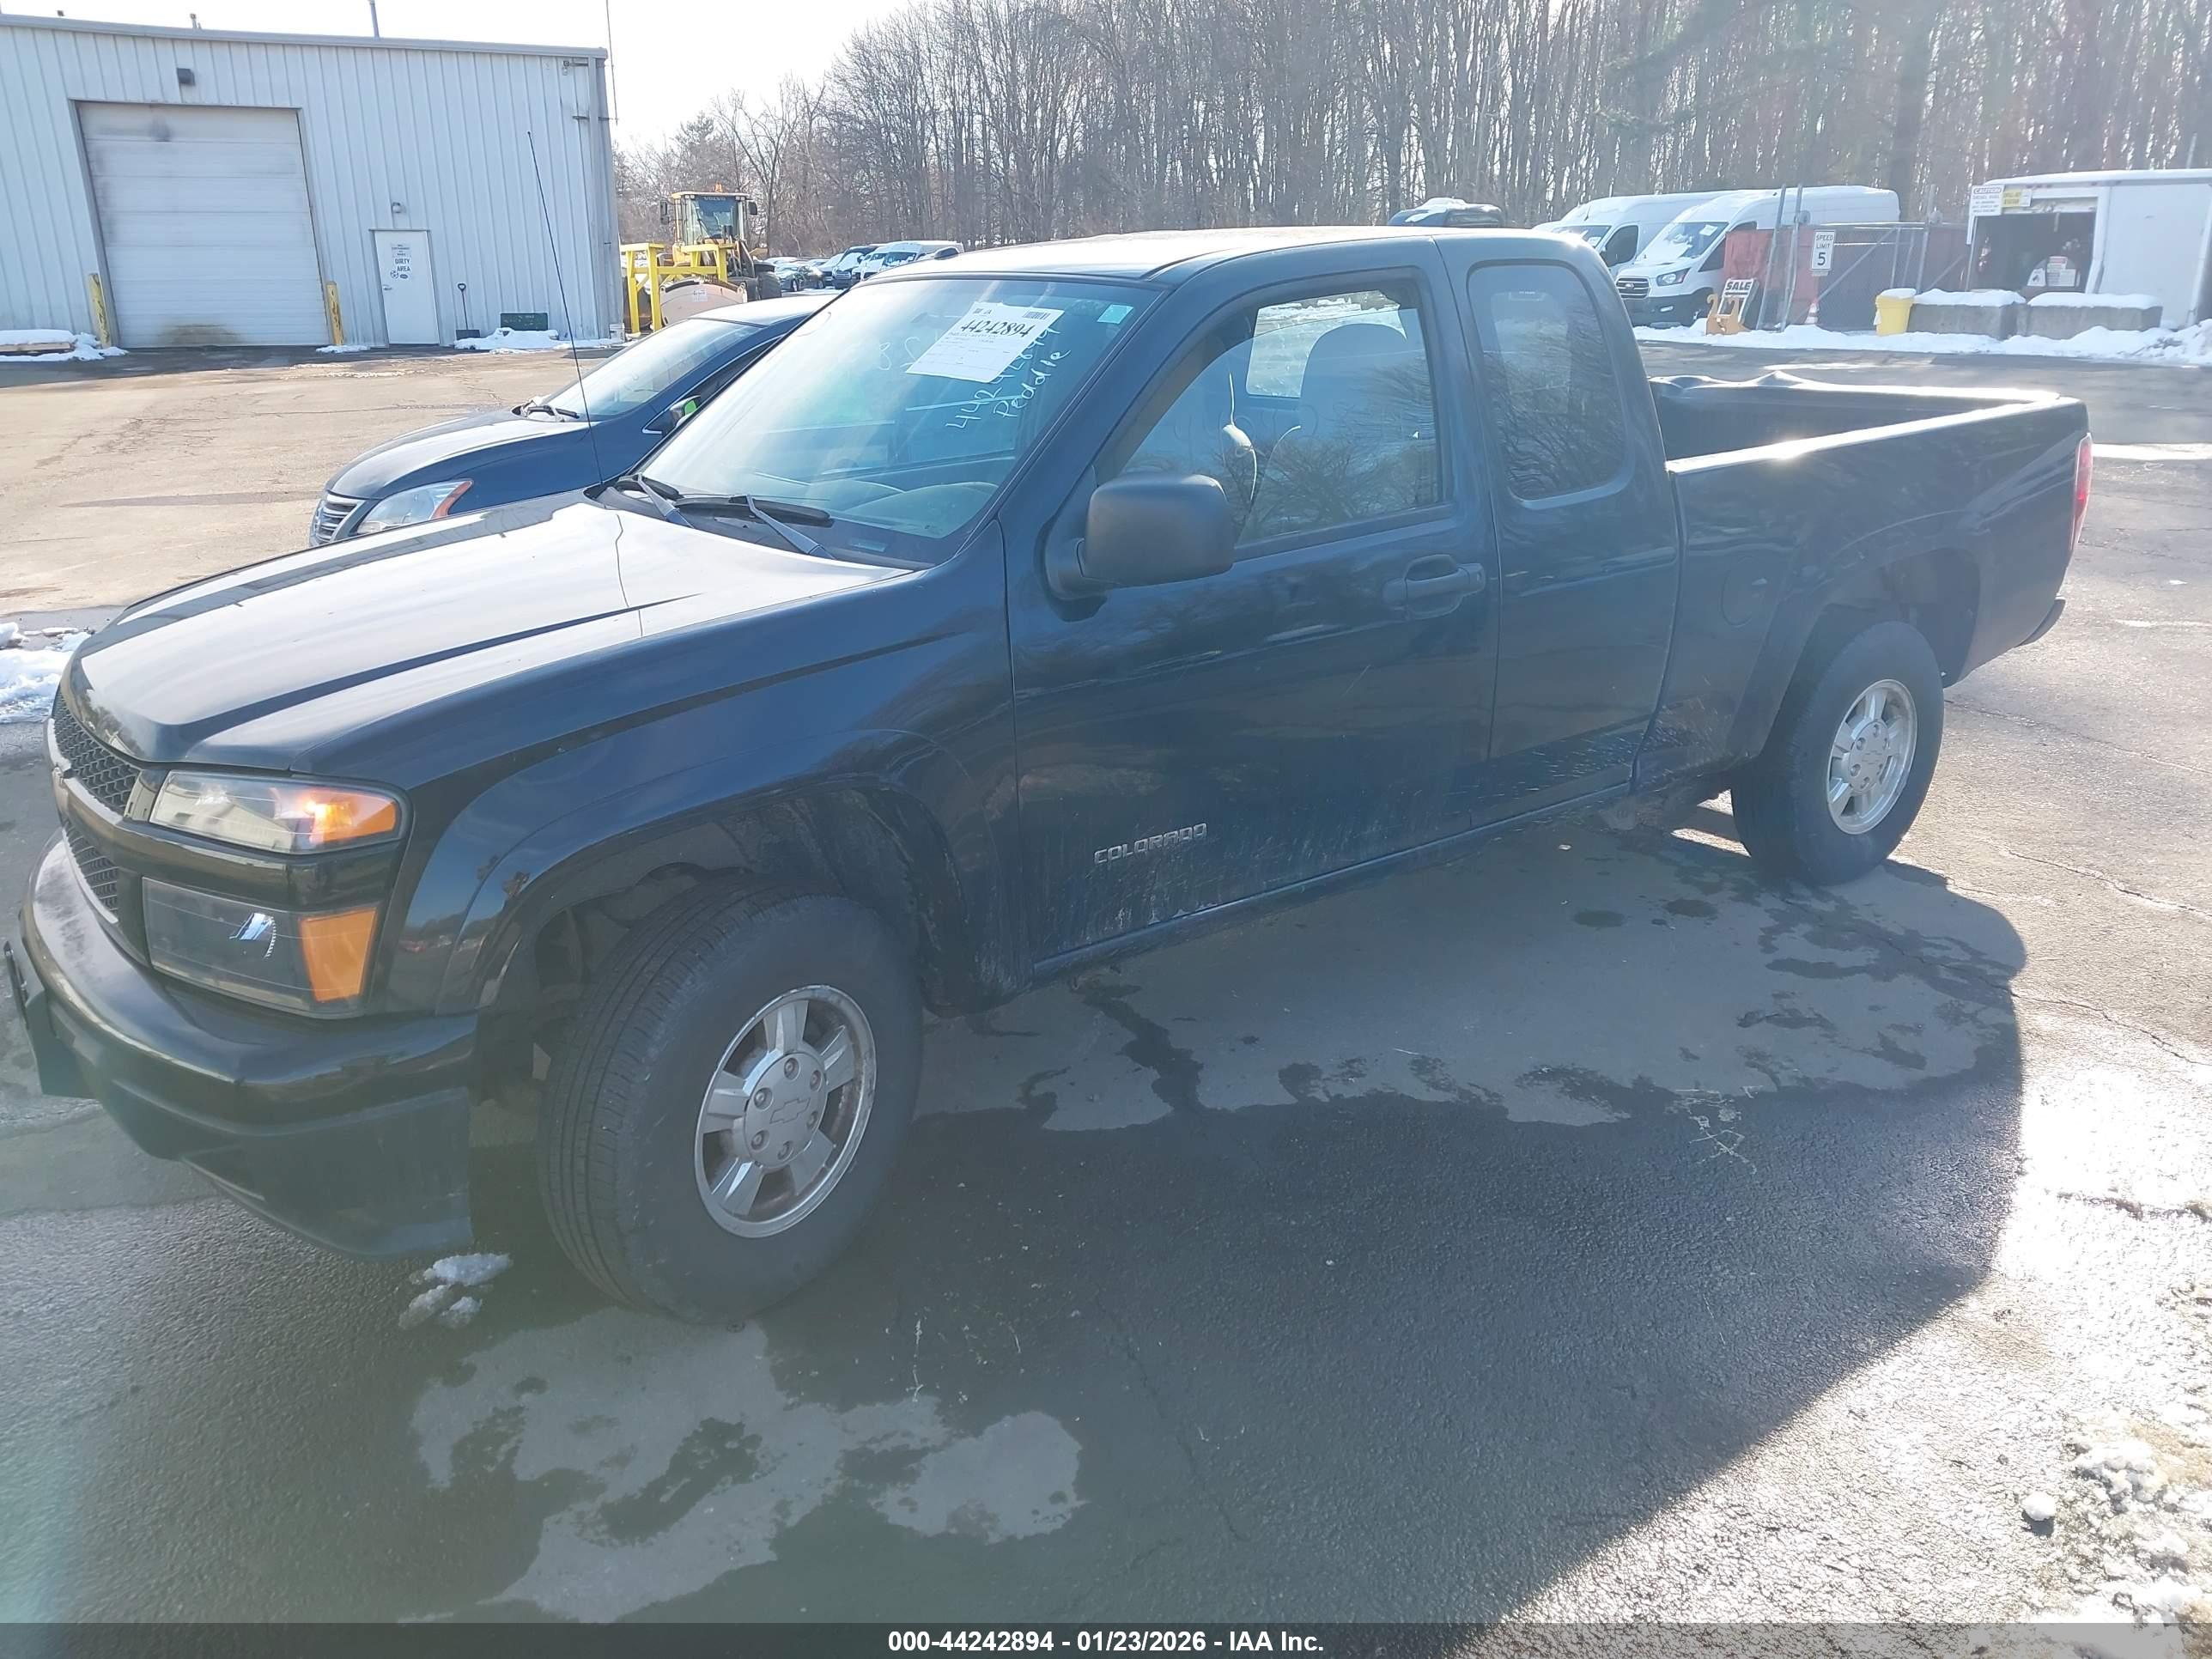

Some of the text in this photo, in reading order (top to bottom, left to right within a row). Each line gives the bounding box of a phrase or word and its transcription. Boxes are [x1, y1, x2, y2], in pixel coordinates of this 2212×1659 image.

[1817, 252, 1826, 266] 5
[1725, 281, 1752, 290] SALE
[960, 319, 1036, 337] 44242894
[1094, 823, 1207, 865] COLORADO
